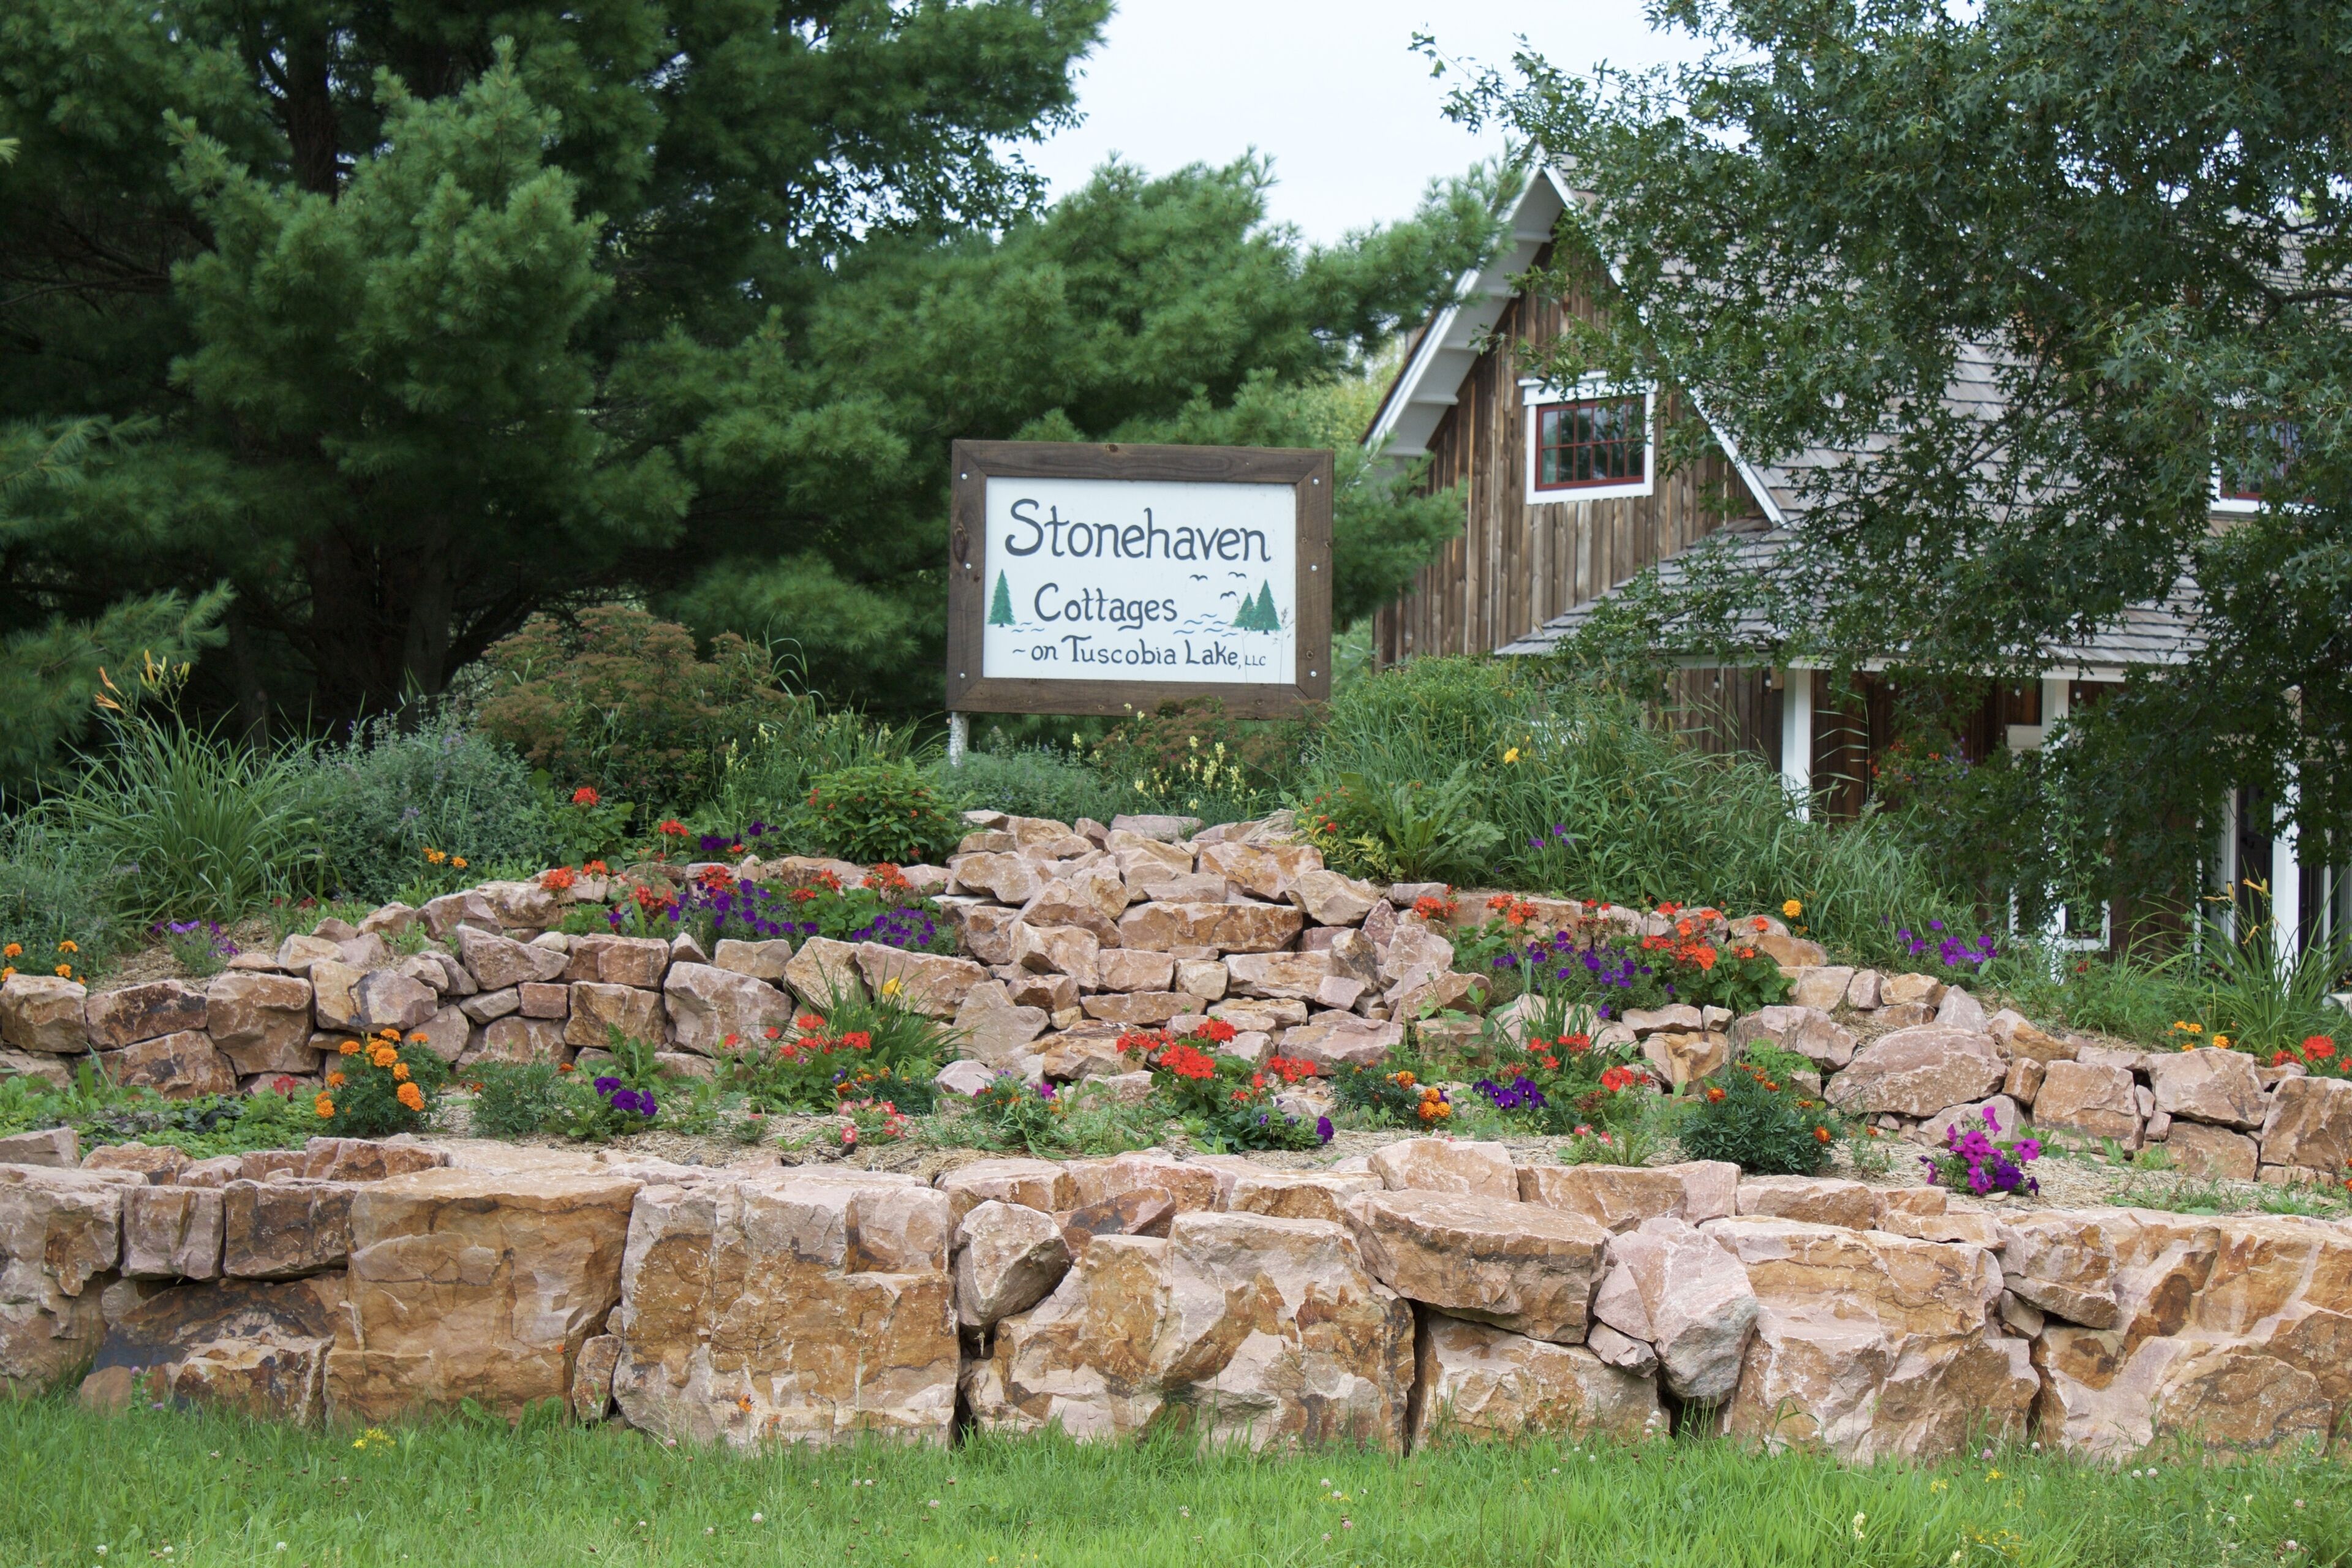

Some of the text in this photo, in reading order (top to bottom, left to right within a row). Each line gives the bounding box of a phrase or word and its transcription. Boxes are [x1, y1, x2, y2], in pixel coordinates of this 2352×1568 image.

[1005, 498, 1271, 562] Stonehaven
[1034, 582, 1178, 631] Cottages
[1031, 635, 1266, 669] on Tuscobia Lake, LLC
